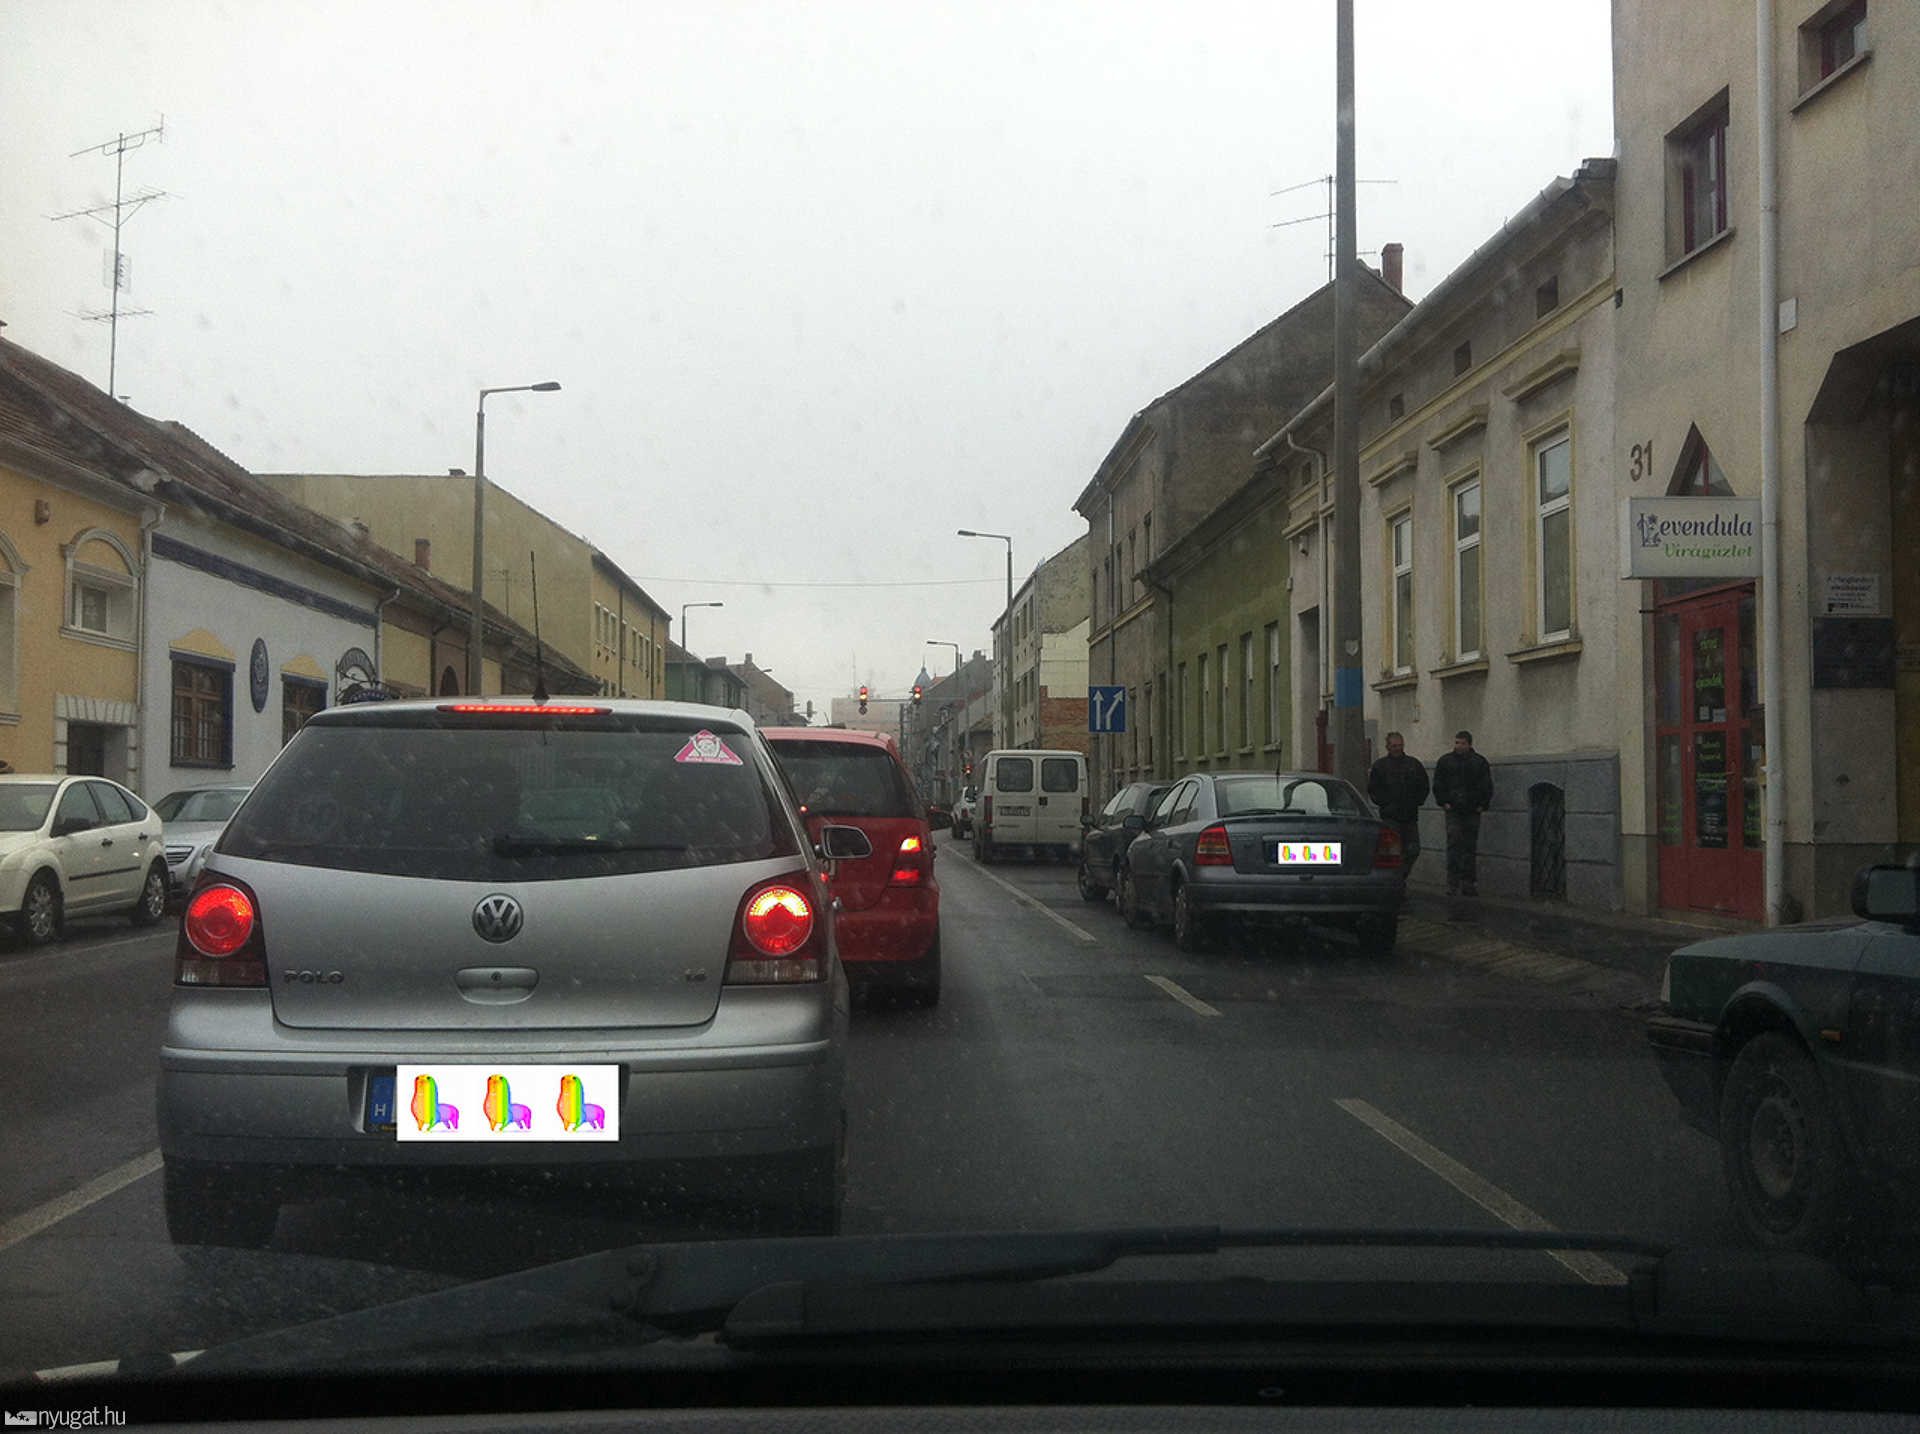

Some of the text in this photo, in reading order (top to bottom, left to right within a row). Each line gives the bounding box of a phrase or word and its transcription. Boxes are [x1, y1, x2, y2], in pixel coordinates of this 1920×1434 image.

[1629, 440, 1653, 482] 31
[283, 968, 345, 985] POLO
[374, 1103, 387, 1117] H
